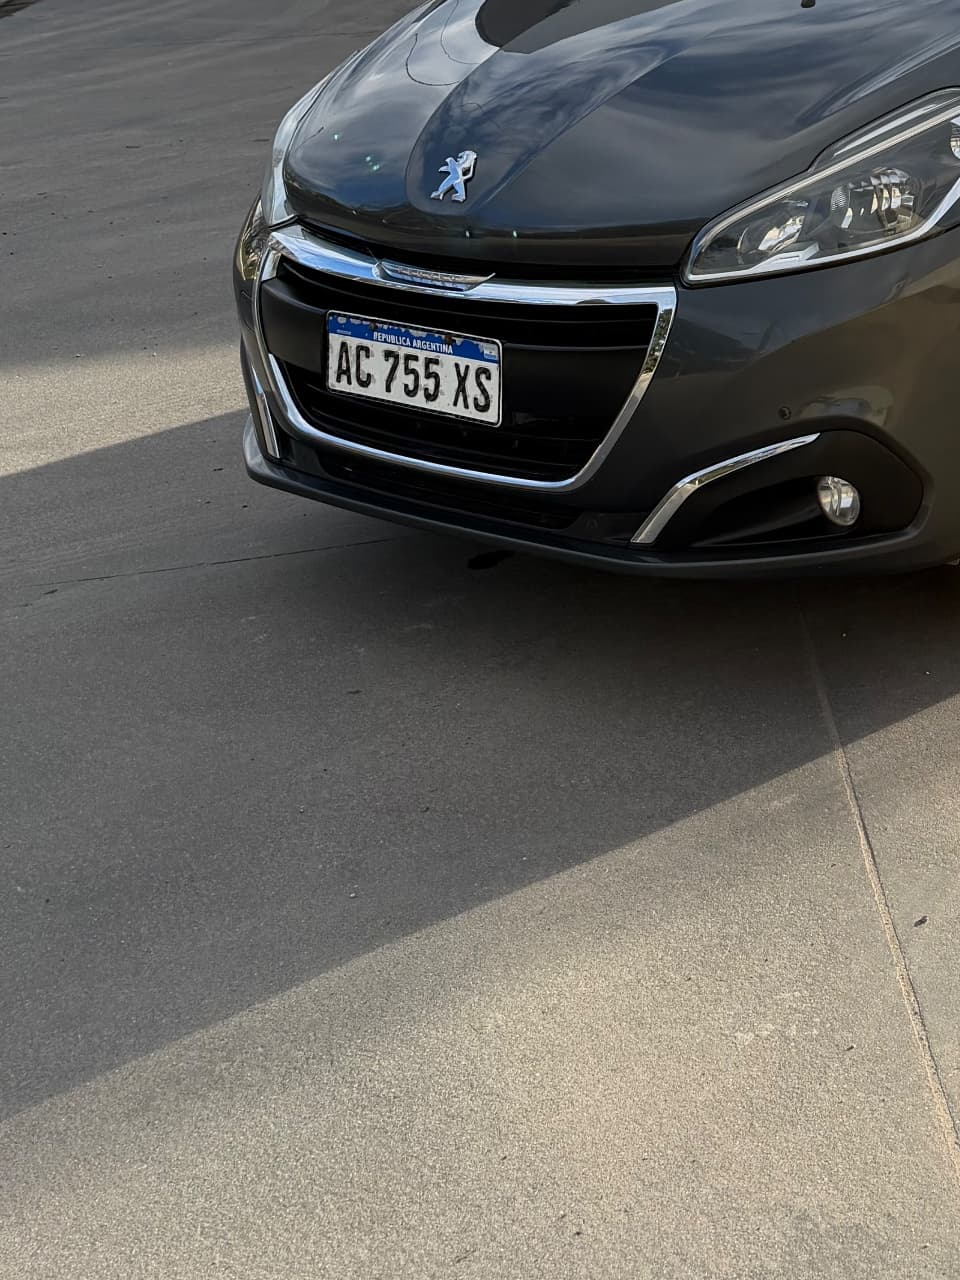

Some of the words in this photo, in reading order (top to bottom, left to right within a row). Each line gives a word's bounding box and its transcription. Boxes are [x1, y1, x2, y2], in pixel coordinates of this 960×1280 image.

[373, 331, 411, 347] REPUBLICA
[412, 340, 454, 355] ARGENTINA
[335, 341, 372, 388] AC
[383, 349, 441, 402] 755
[452, 362, 492, 413] XS
